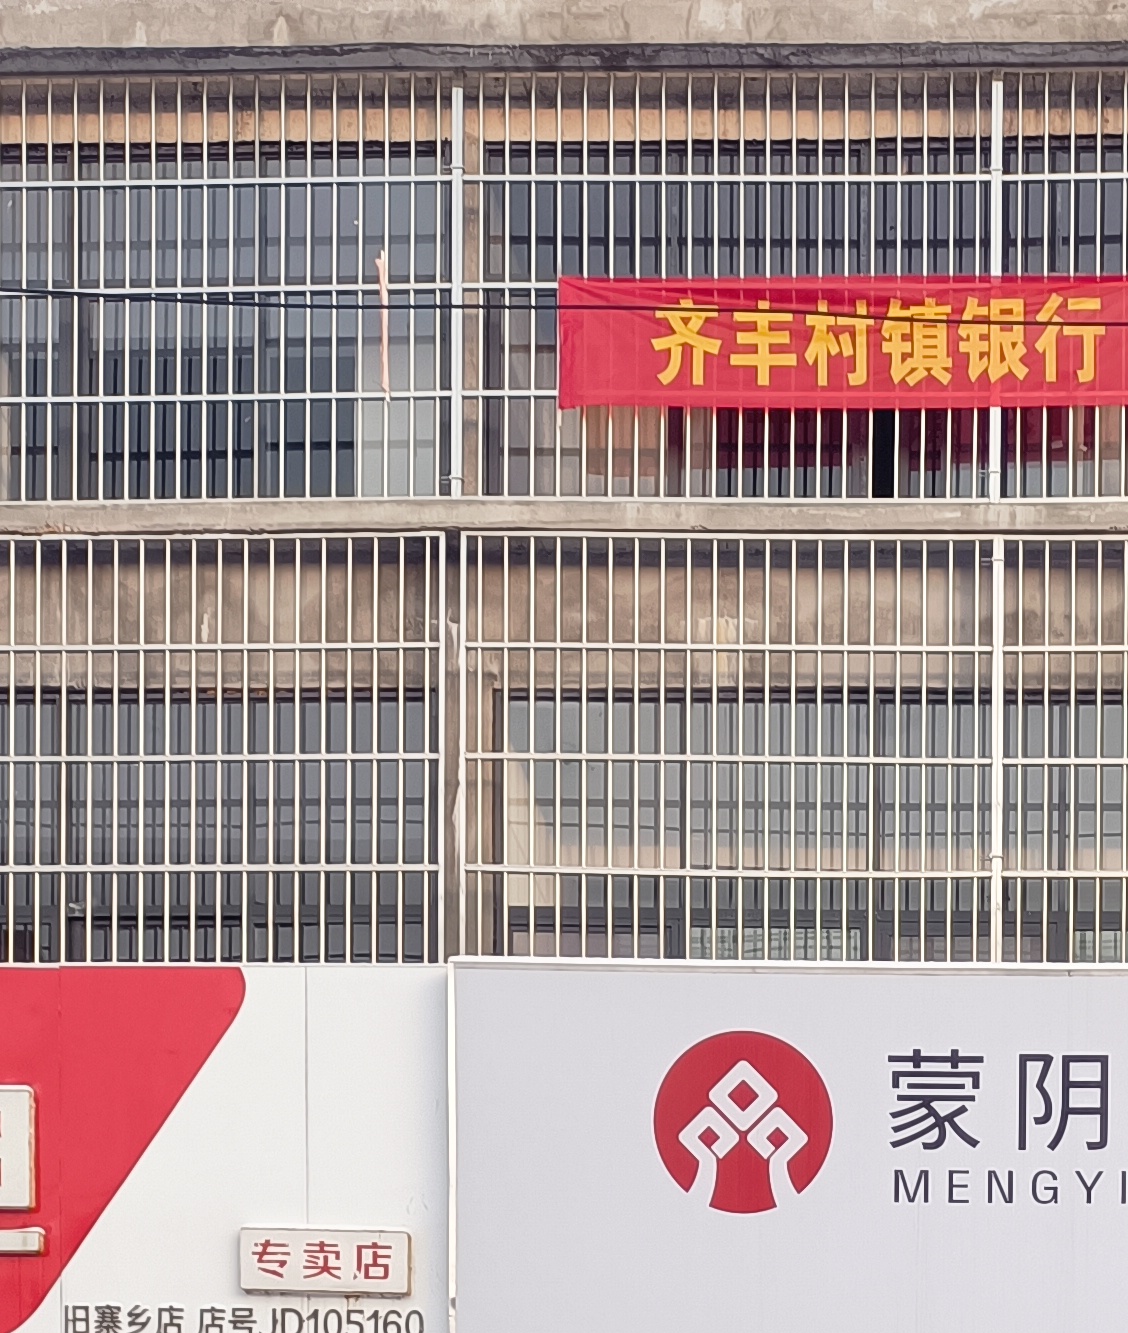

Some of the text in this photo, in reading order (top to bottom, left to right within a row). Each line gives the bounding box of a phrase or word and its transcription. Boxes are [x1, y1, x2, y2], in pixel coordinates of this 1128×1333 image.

[650, 291, 1106, 387] 齐丰村镇银行
[251, 1238, 393, 1281] 专卖店
